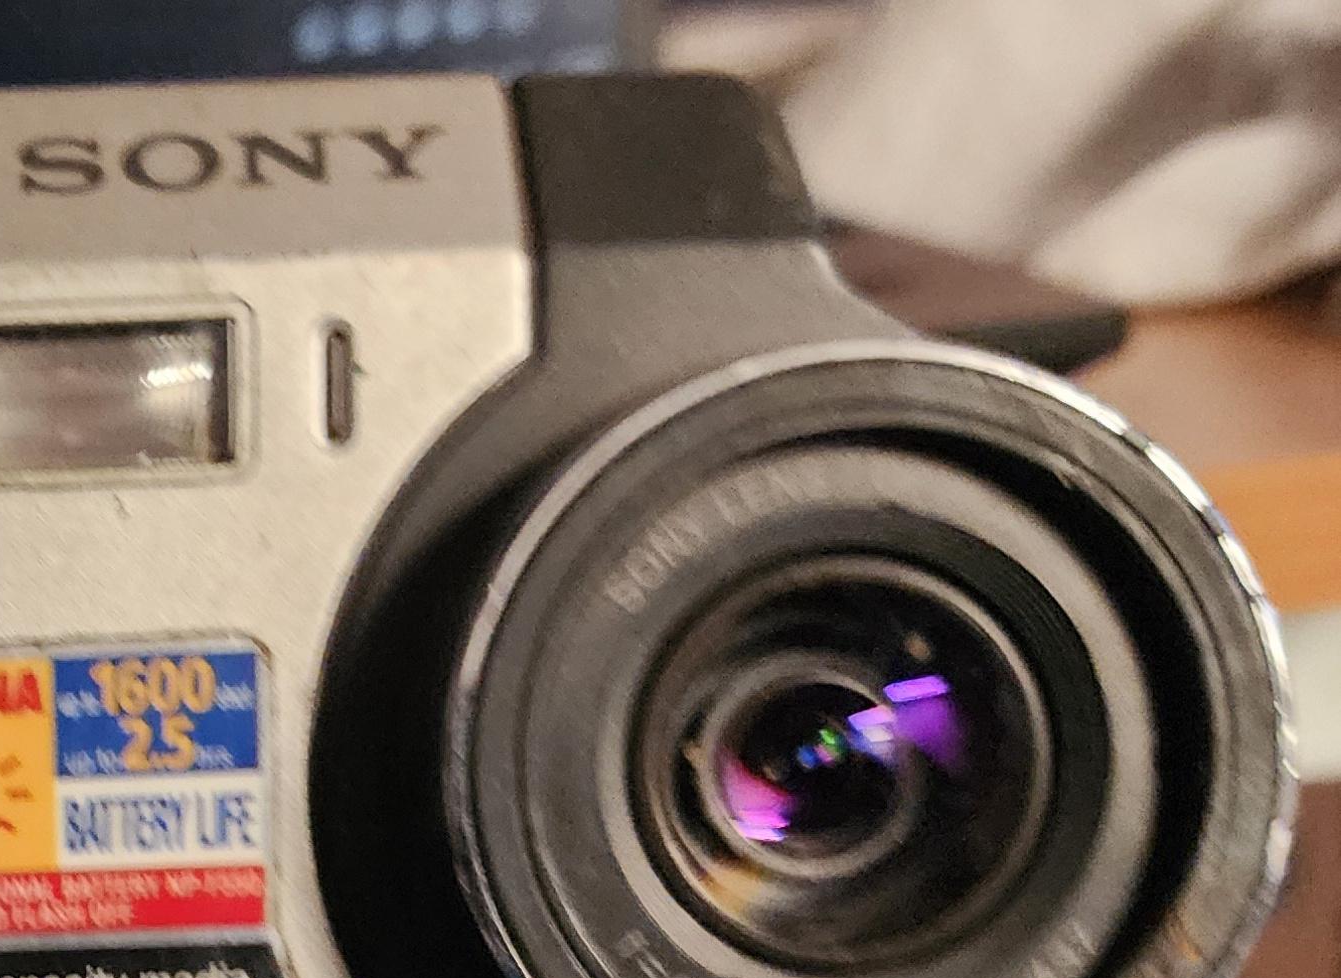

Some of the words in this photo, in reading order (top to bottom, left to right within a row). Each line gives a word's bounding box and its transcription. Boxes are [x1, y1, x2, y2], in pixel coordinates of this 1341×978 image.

[16, 124, 446, 196] SONY
[89, 655, 217, 715] 1600
[118, 710, 196, 770] 2.5
[65, 793, 187, 854] BATTERY
[200, 788, 257, 848] LIFE
[11, 898, 86, 930] FLASH
